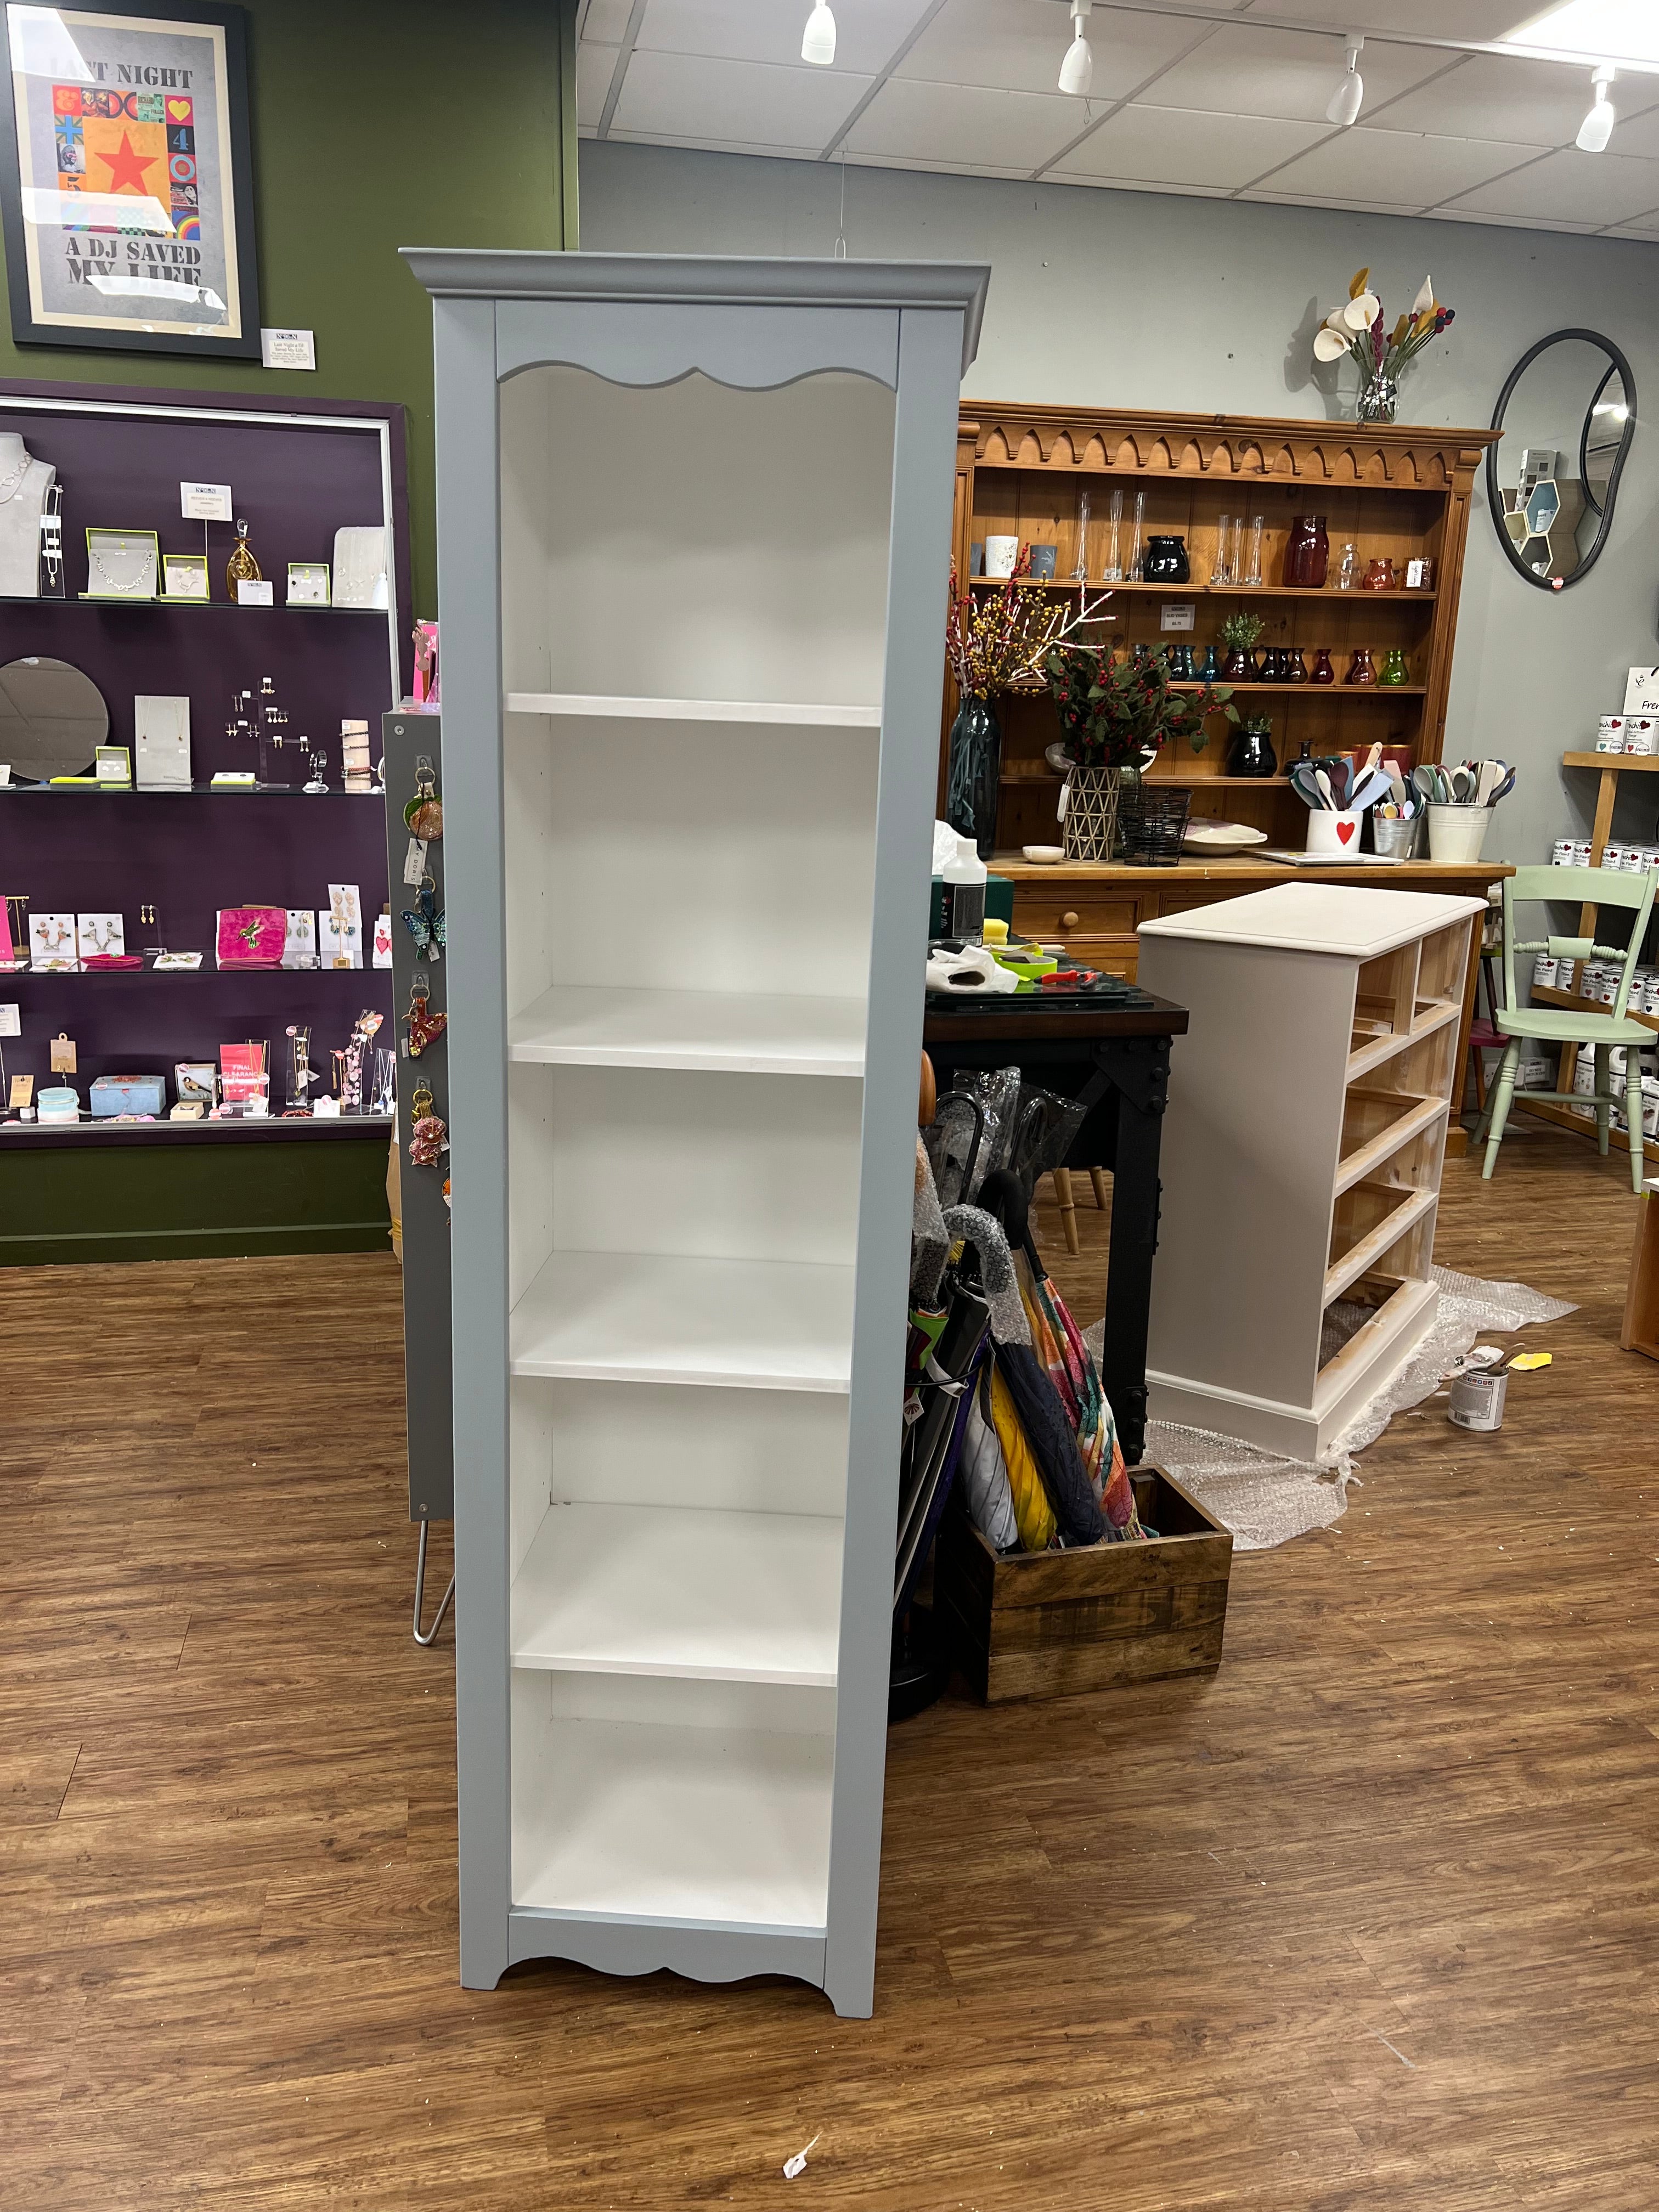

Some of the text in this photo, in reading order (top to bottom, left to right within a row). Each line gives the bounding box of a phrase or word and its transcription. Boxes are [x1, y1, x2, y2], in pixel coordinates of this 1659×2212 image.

[116, 64, 194, 89] NIGHT
[173, 128, 189, 150] 4
[66, 237, 201, 264] A DJ SAVED
